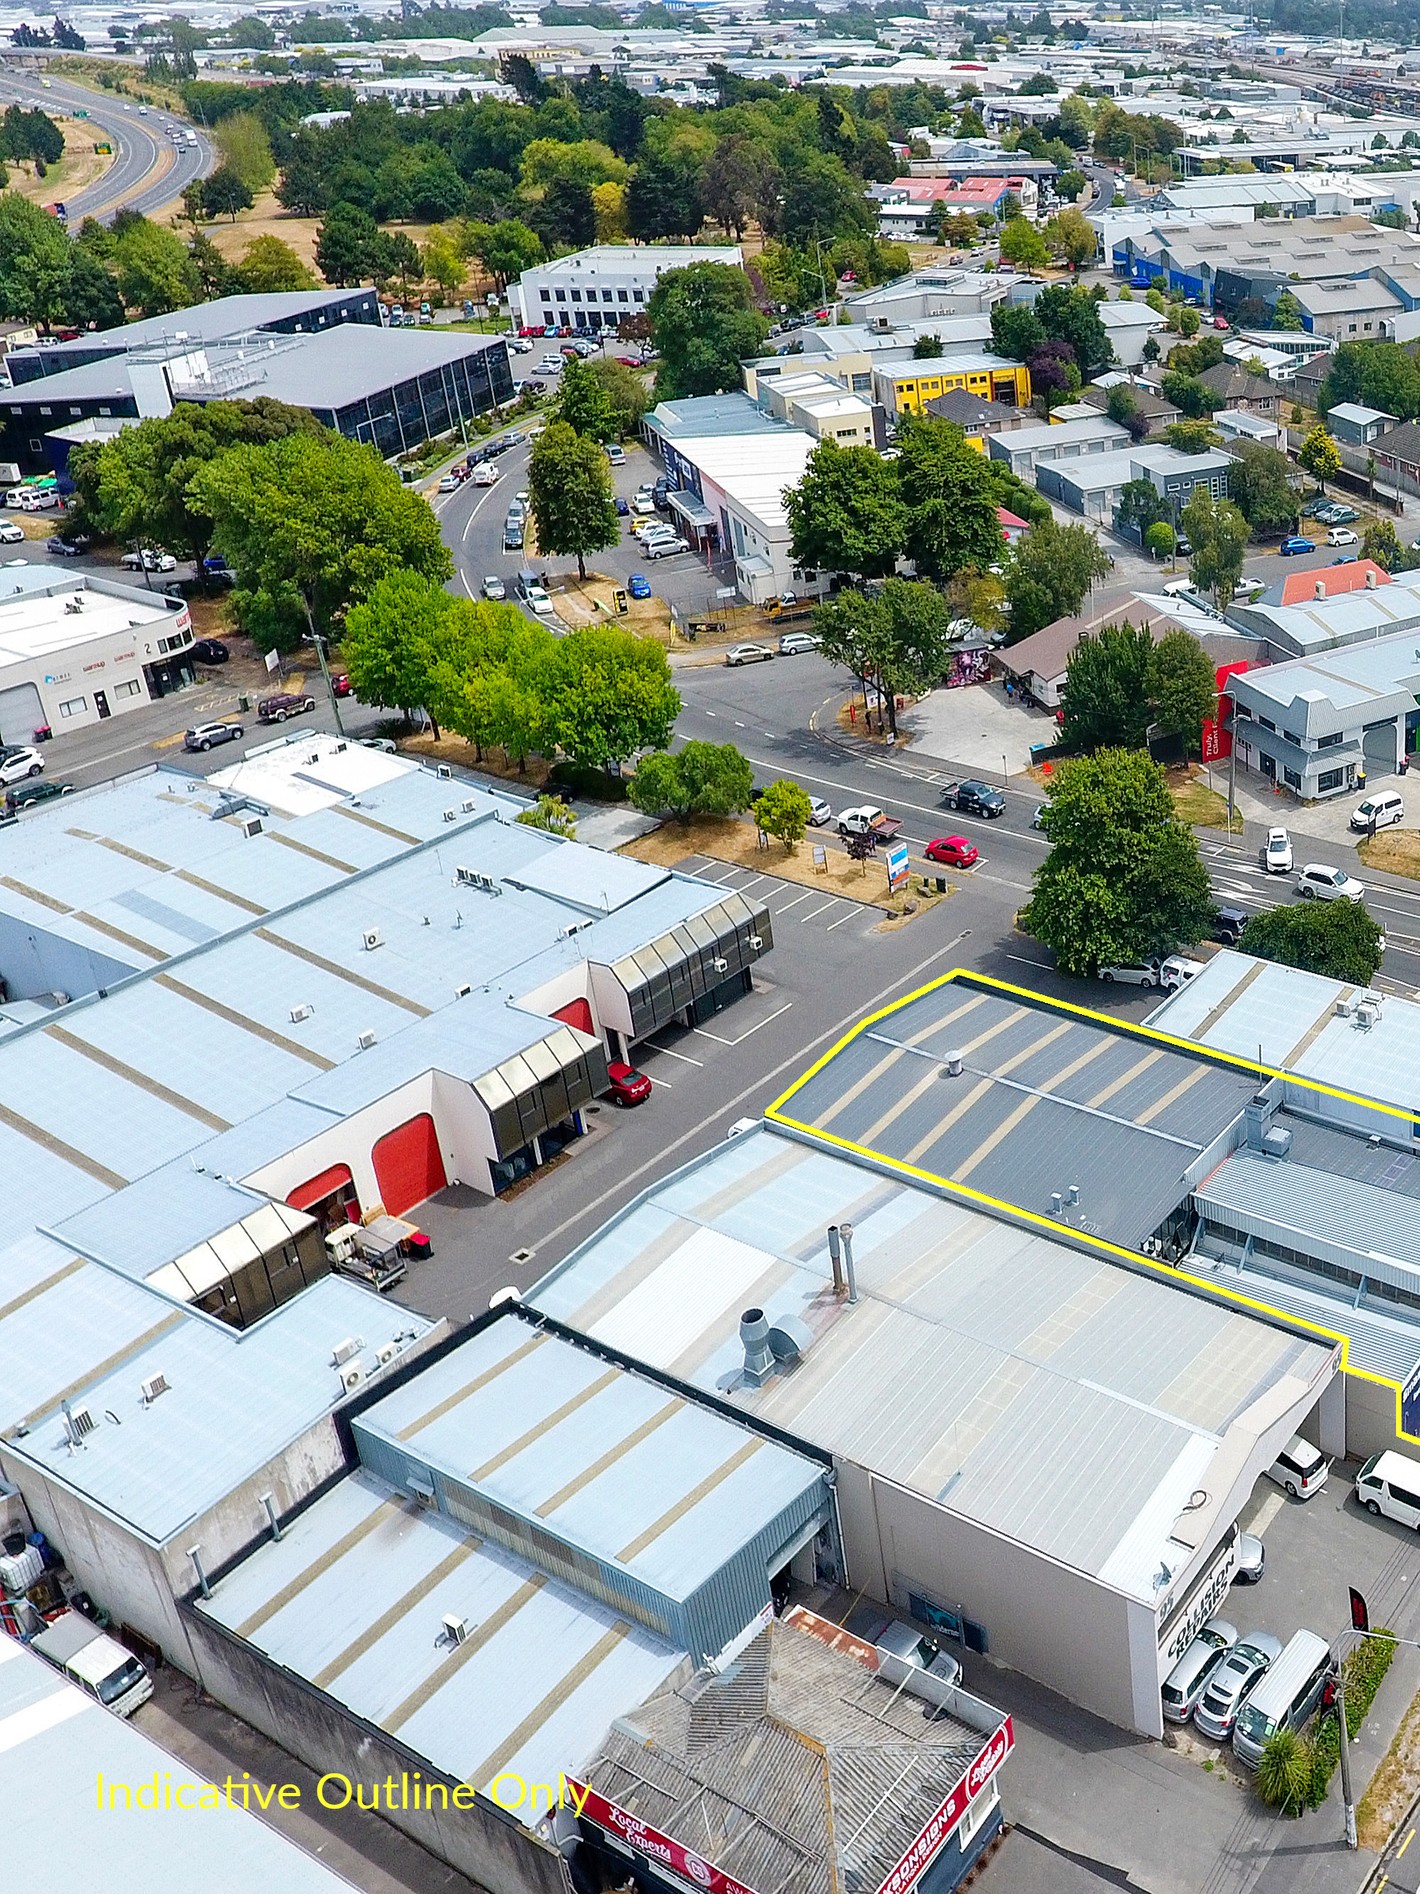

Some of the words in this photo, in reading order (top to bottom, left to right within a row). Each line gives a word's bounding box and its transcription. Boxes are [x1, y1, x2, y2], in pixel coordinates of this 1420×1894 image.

[1159, 1591, 1174, 1622] 95
[1167, 1553, 1235, 1658] COLLISION
[1176, 1577, 1229, 1660] REPAIRS
[608, 1806, 648, 1836] Local
[625, 1829, 672, 1863] Experts
